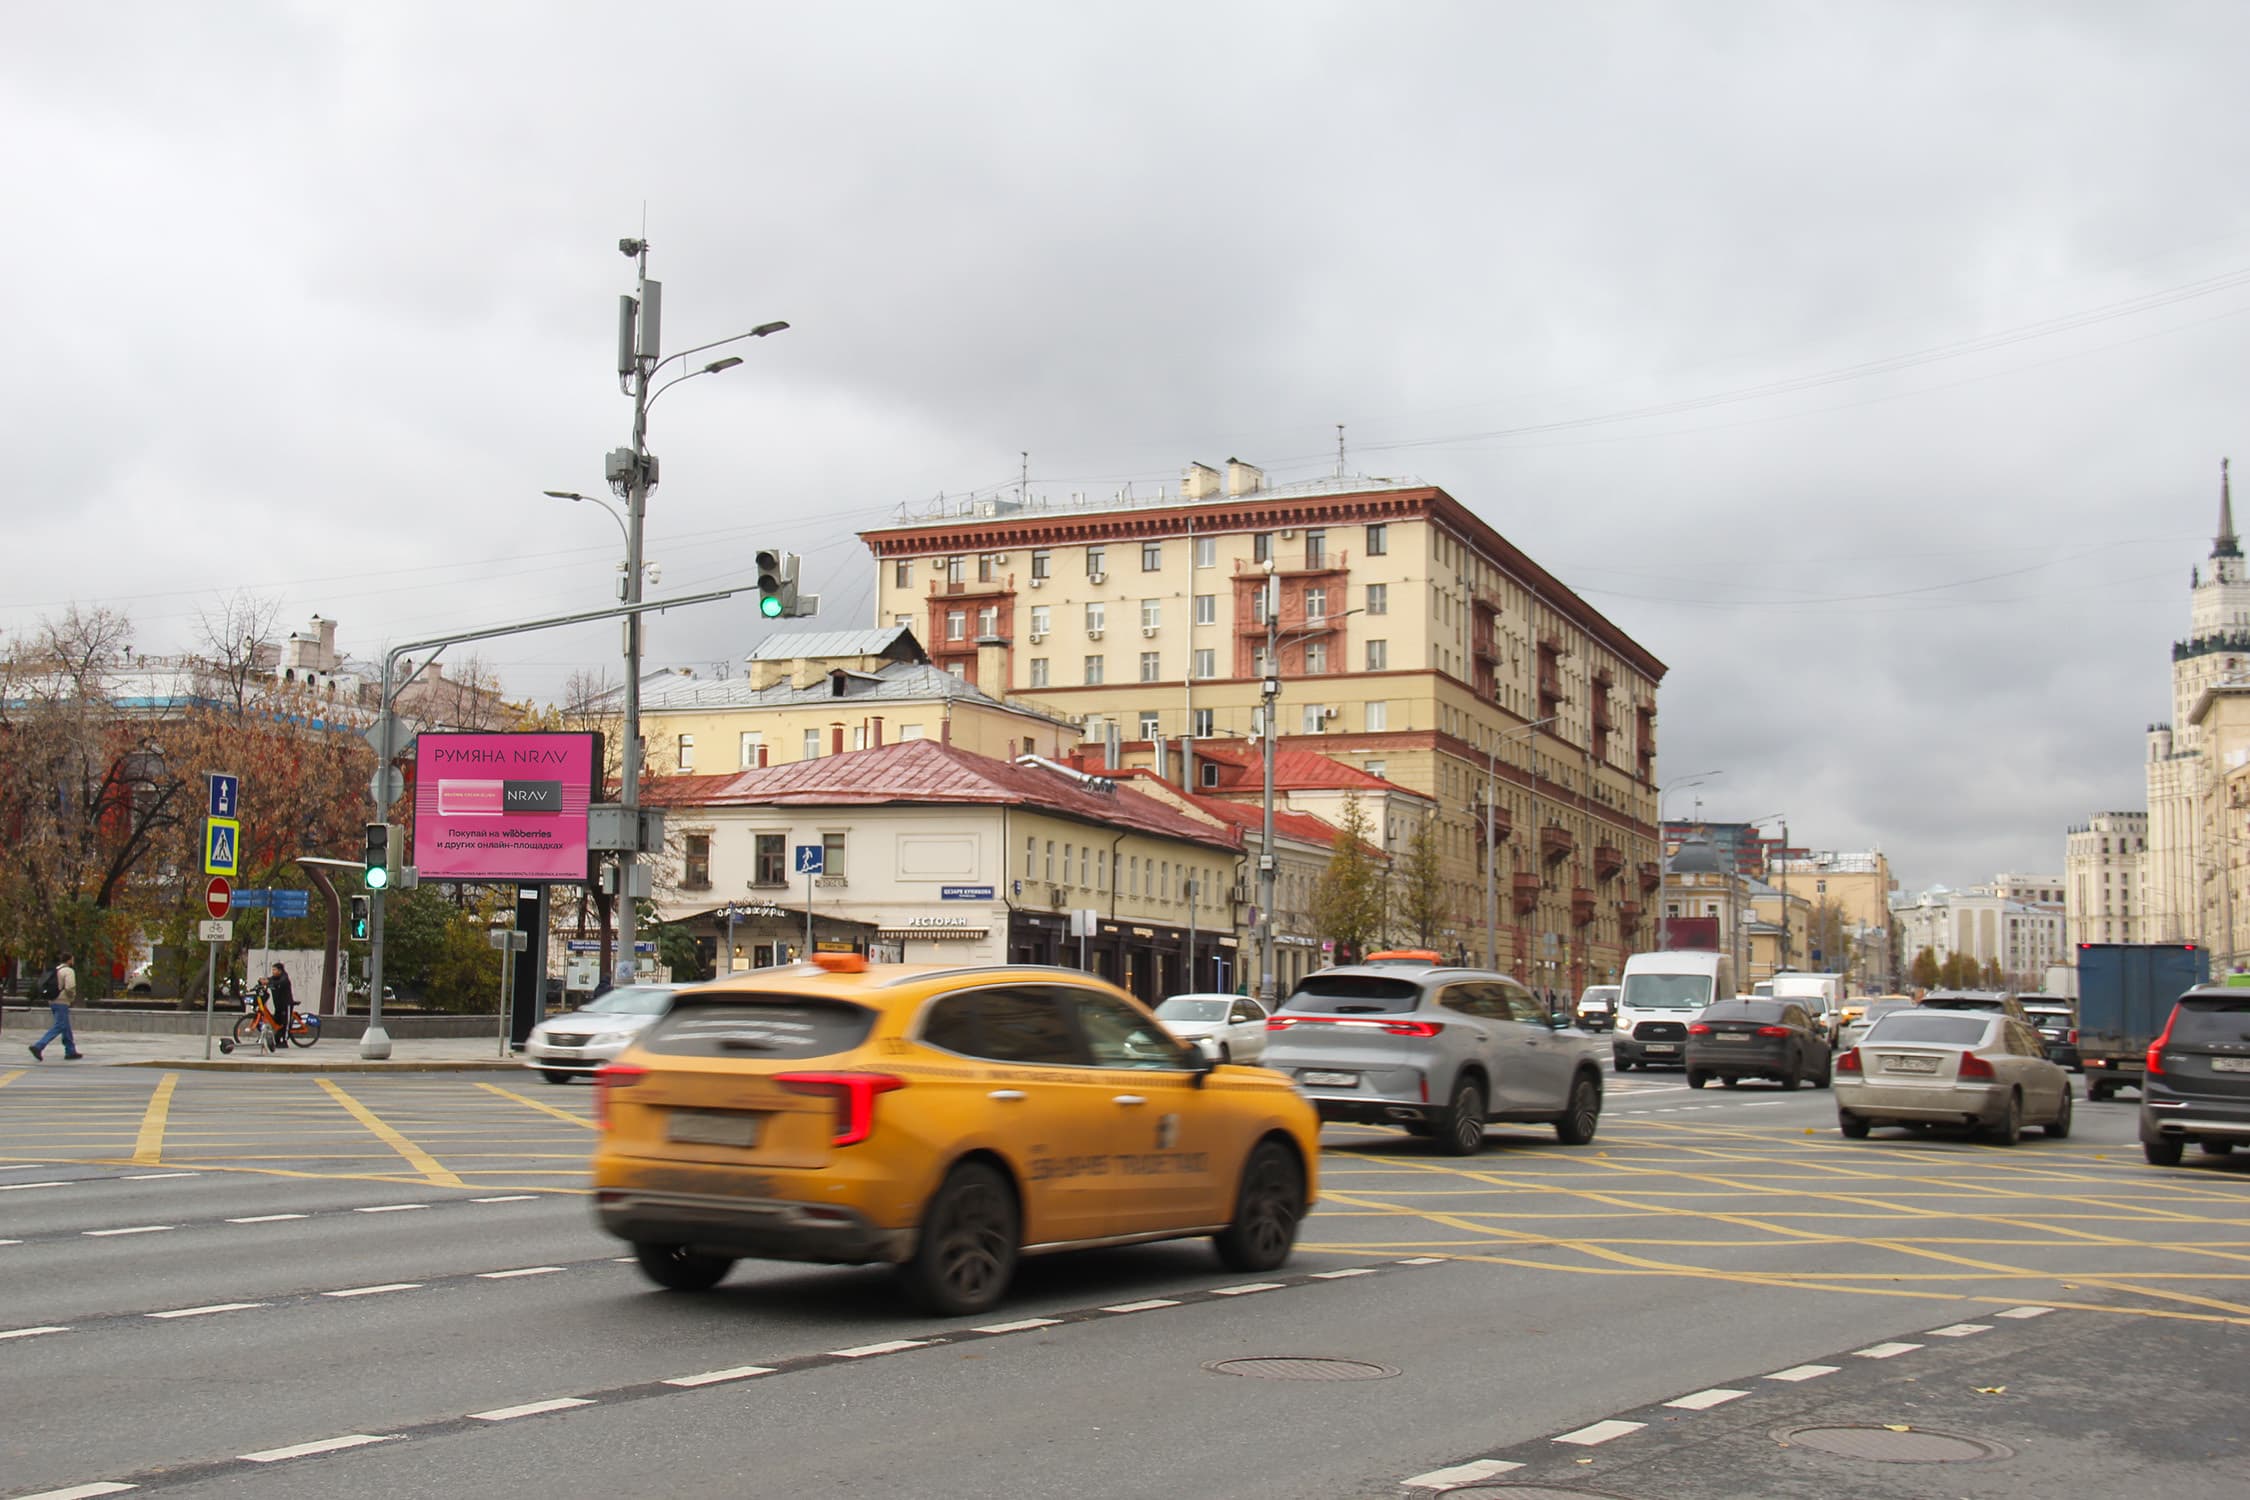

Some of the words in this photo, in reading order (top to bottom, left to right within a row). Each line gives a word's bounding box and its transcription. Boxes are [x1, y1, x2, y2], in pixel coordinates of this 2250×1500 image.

[434, 749, 506, 762] РУМЯНА
[513, 750, 568, 763] NRAV
[506, 790, 548, 801] NRAV
[448, 829, 487, 839] Покупай
[436, 841, 443, 849] и
[444, 841, 475, 850] других
[477, 841, 563, 850] онлайн-площадках
[908, 917, 967, 926] РЕСТОРАН
